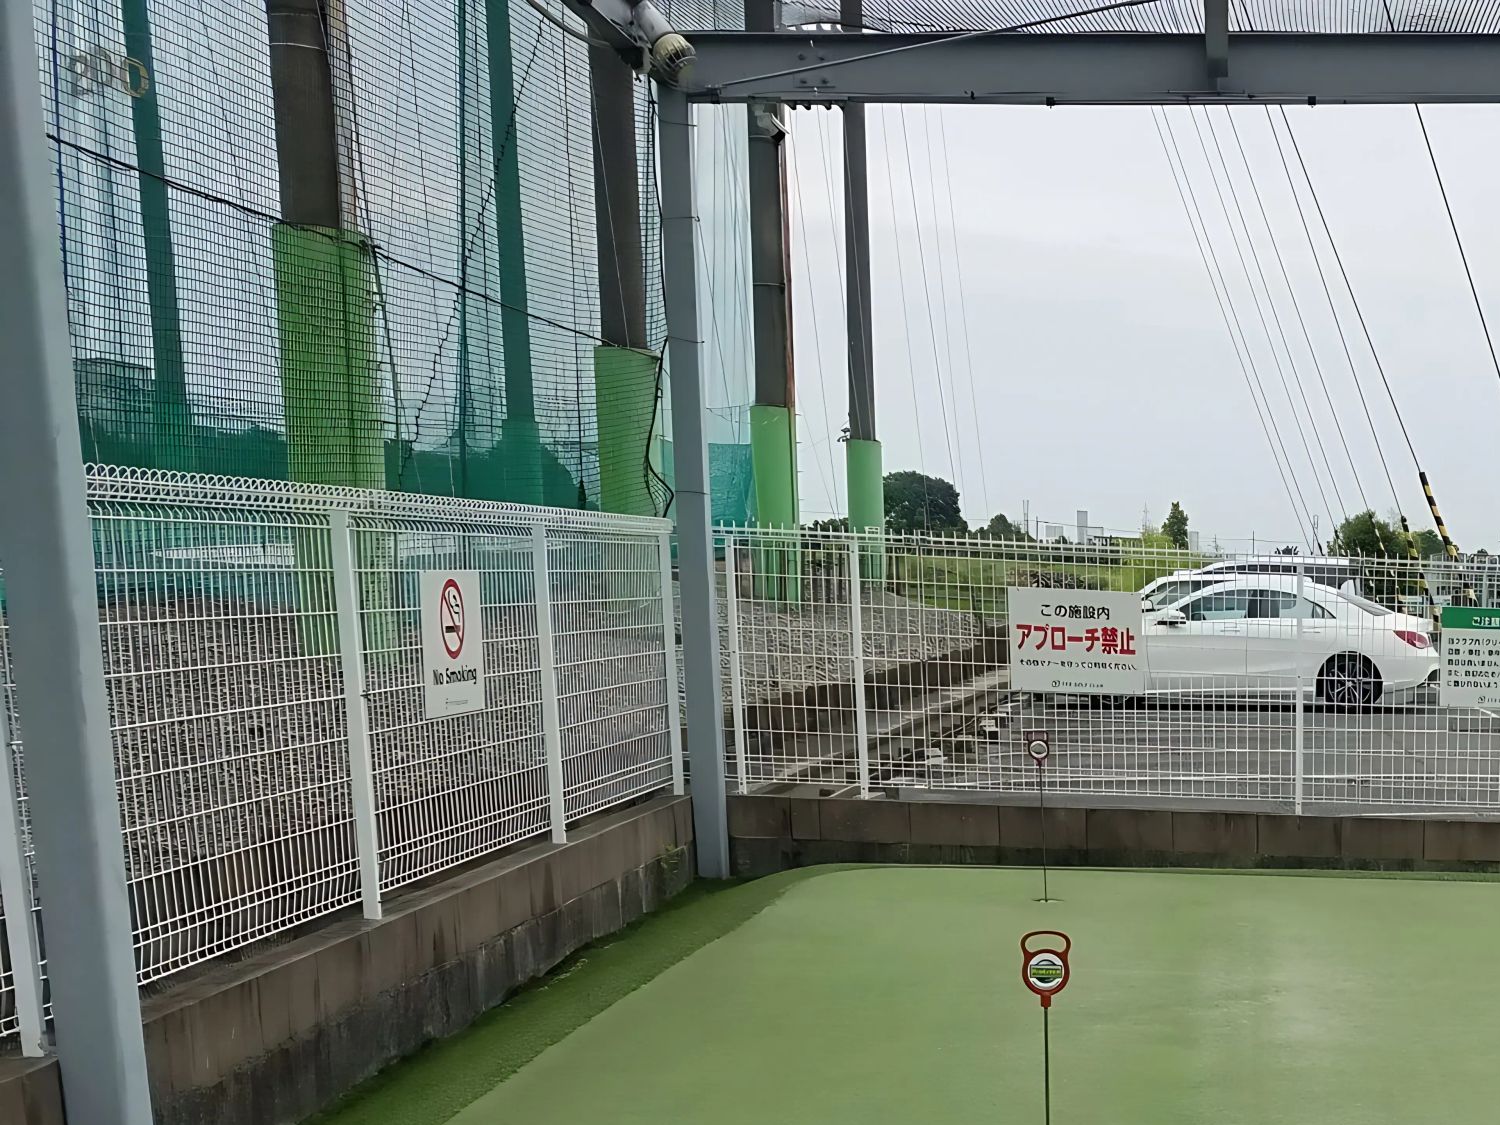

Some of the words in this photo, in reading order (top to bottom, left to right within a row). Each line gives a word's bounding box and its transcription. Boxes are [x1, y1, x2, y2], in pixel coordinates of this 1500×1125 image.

[1041, 604, 1110, 620] この施設内
[1016, 624, 1136, 655] アプローチ禁止
[433, 669, 444, 686] No
[446, 665, 477, 685] Smoking
